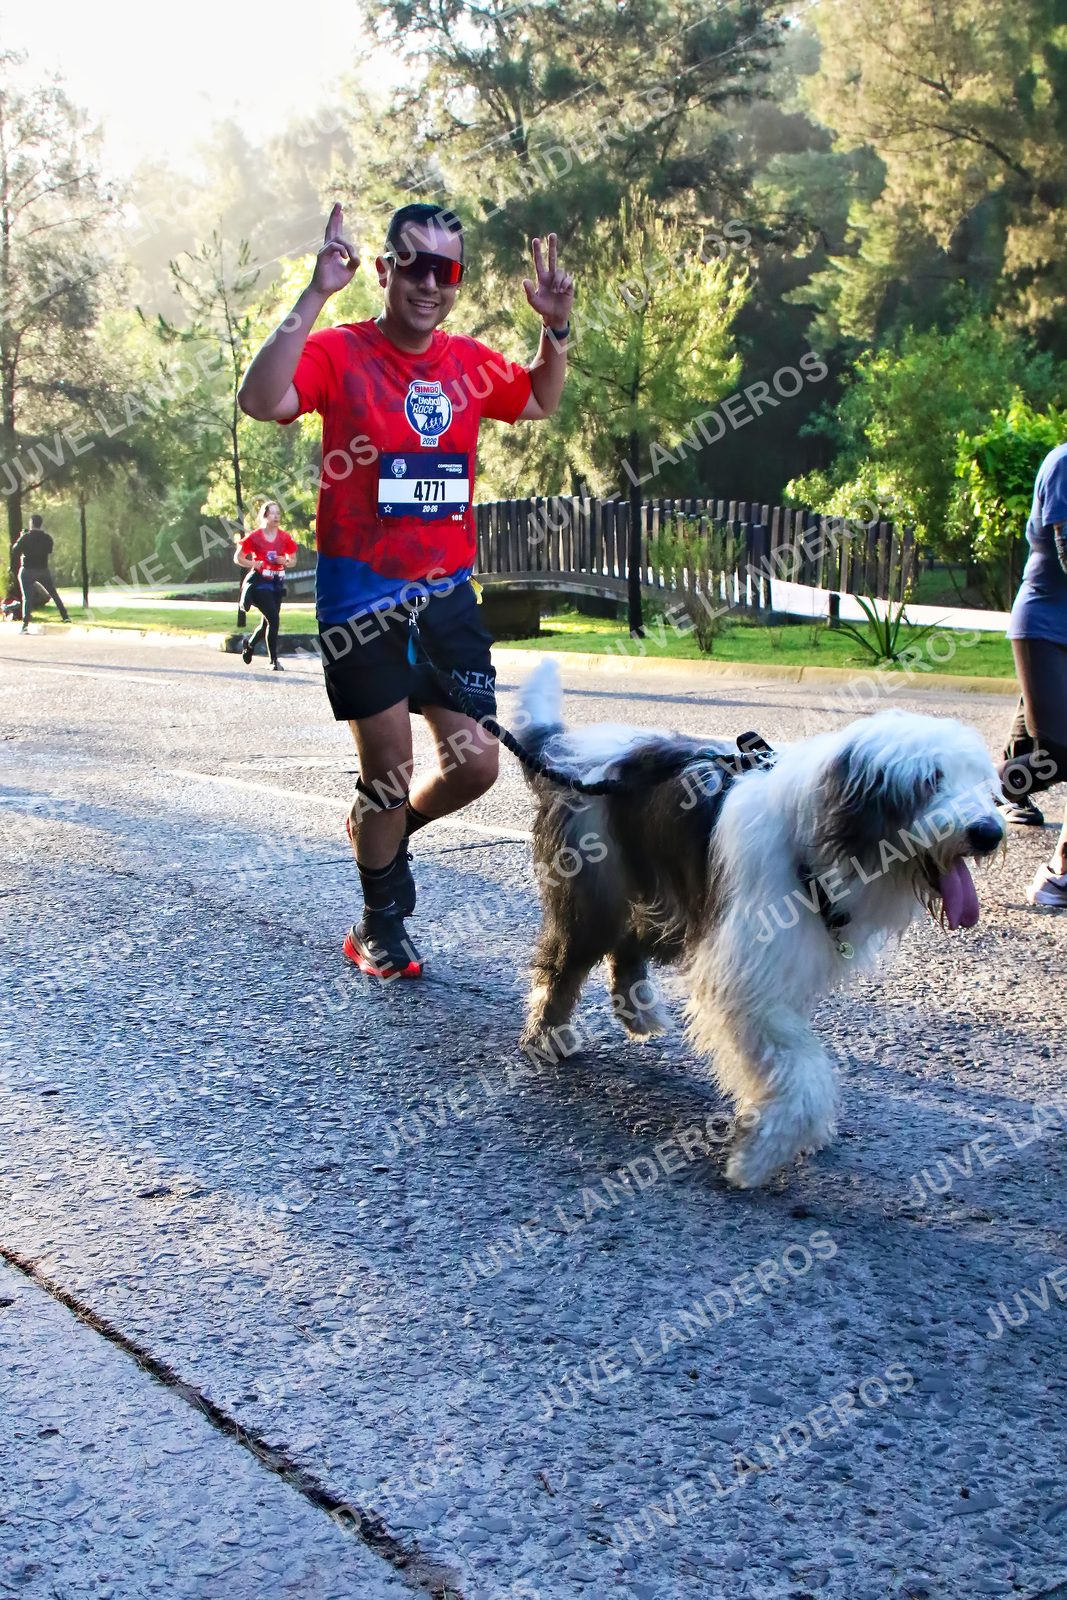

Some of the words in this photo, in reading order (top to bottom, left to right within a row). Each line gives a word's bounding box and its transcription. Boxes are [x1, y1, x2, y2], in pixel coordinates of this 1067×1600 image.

[414, 386, 439, 394] BIMBO
[418, 397, 442, 406] Global
[412, 404, 434, 415] Race
[422, 437, 438, 446] 2026
[413, 480, 446, 502] 4771
